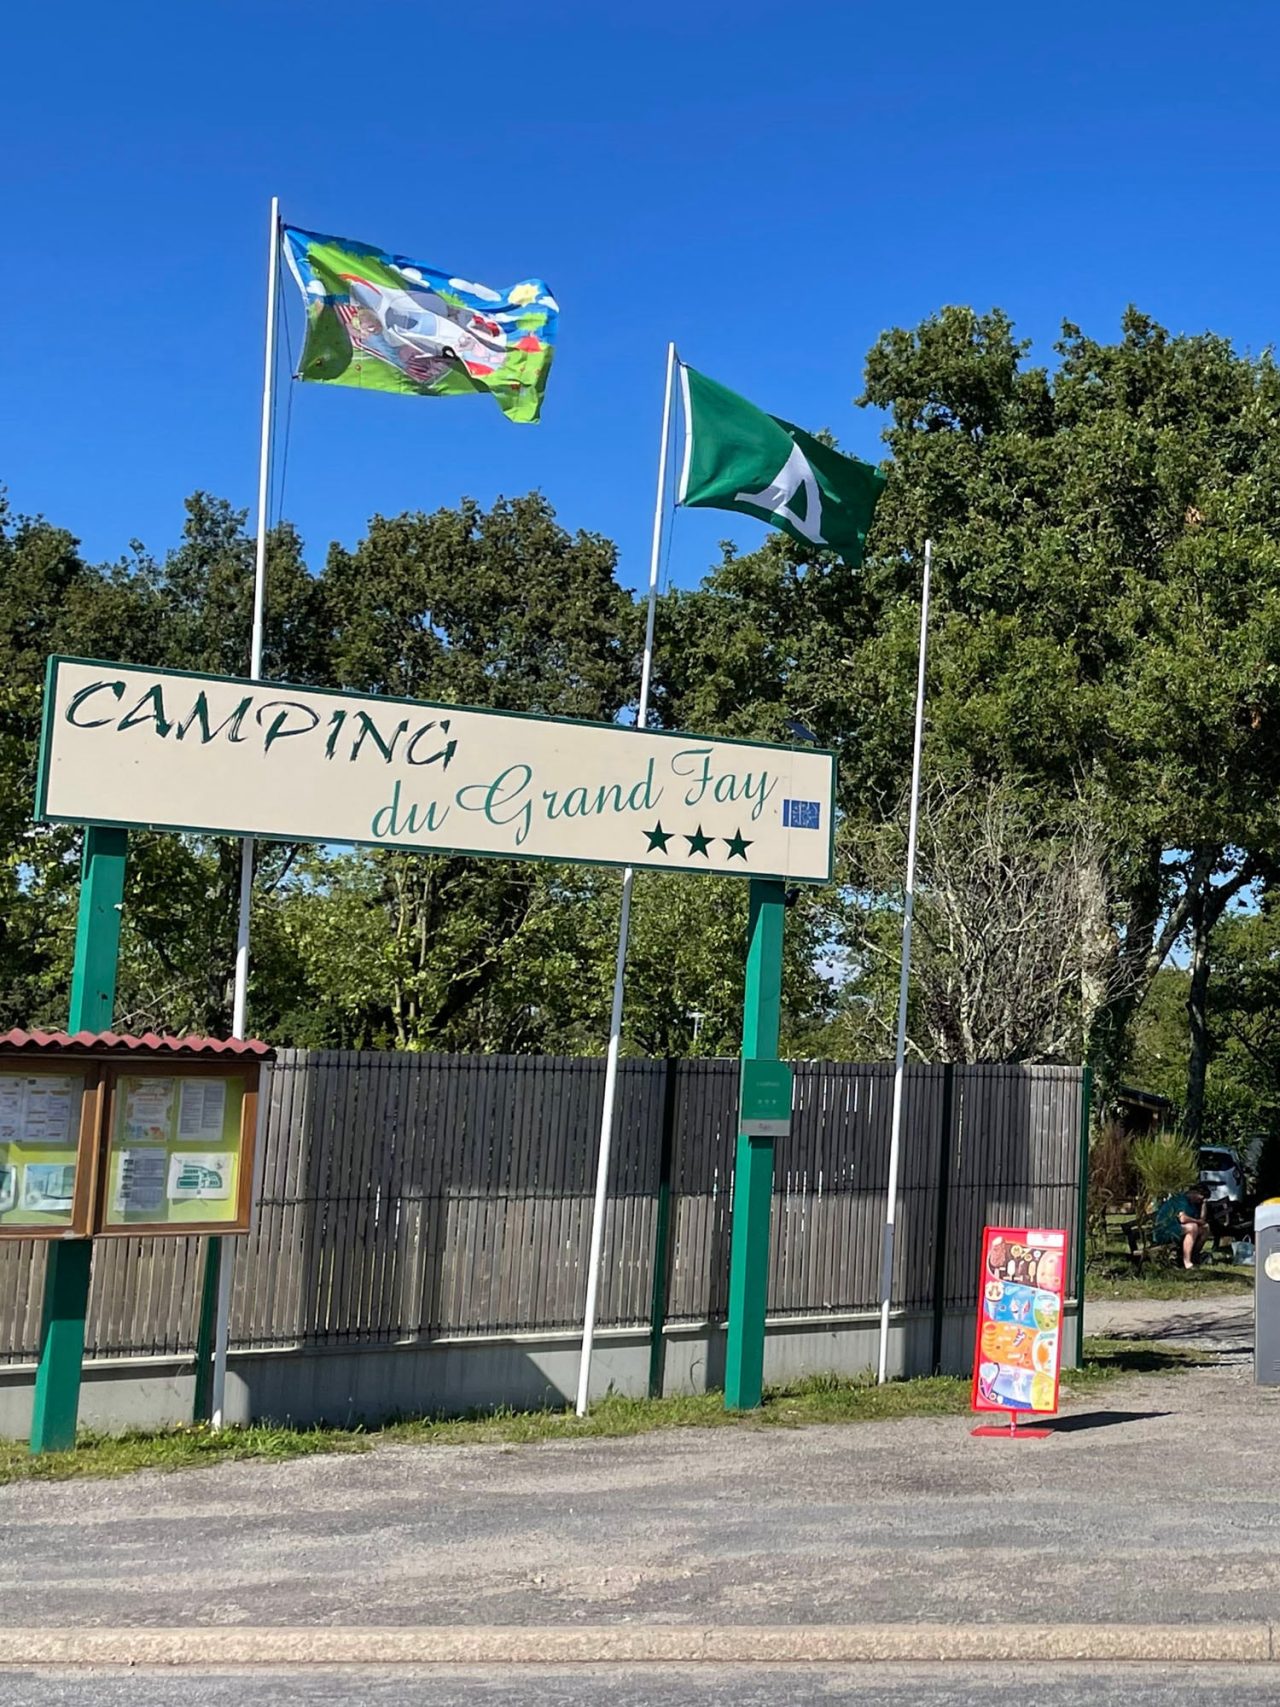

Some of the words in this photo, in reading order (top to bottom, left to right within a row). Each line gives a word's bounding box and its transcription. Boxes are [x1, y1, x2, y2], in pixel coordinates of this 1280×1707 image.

[66, 681, 457, 771] CAMPING
[371, 780, 449, 838] du
[456, 757, 661, 844] Grand
[672, 748, 779, 821] Fay
